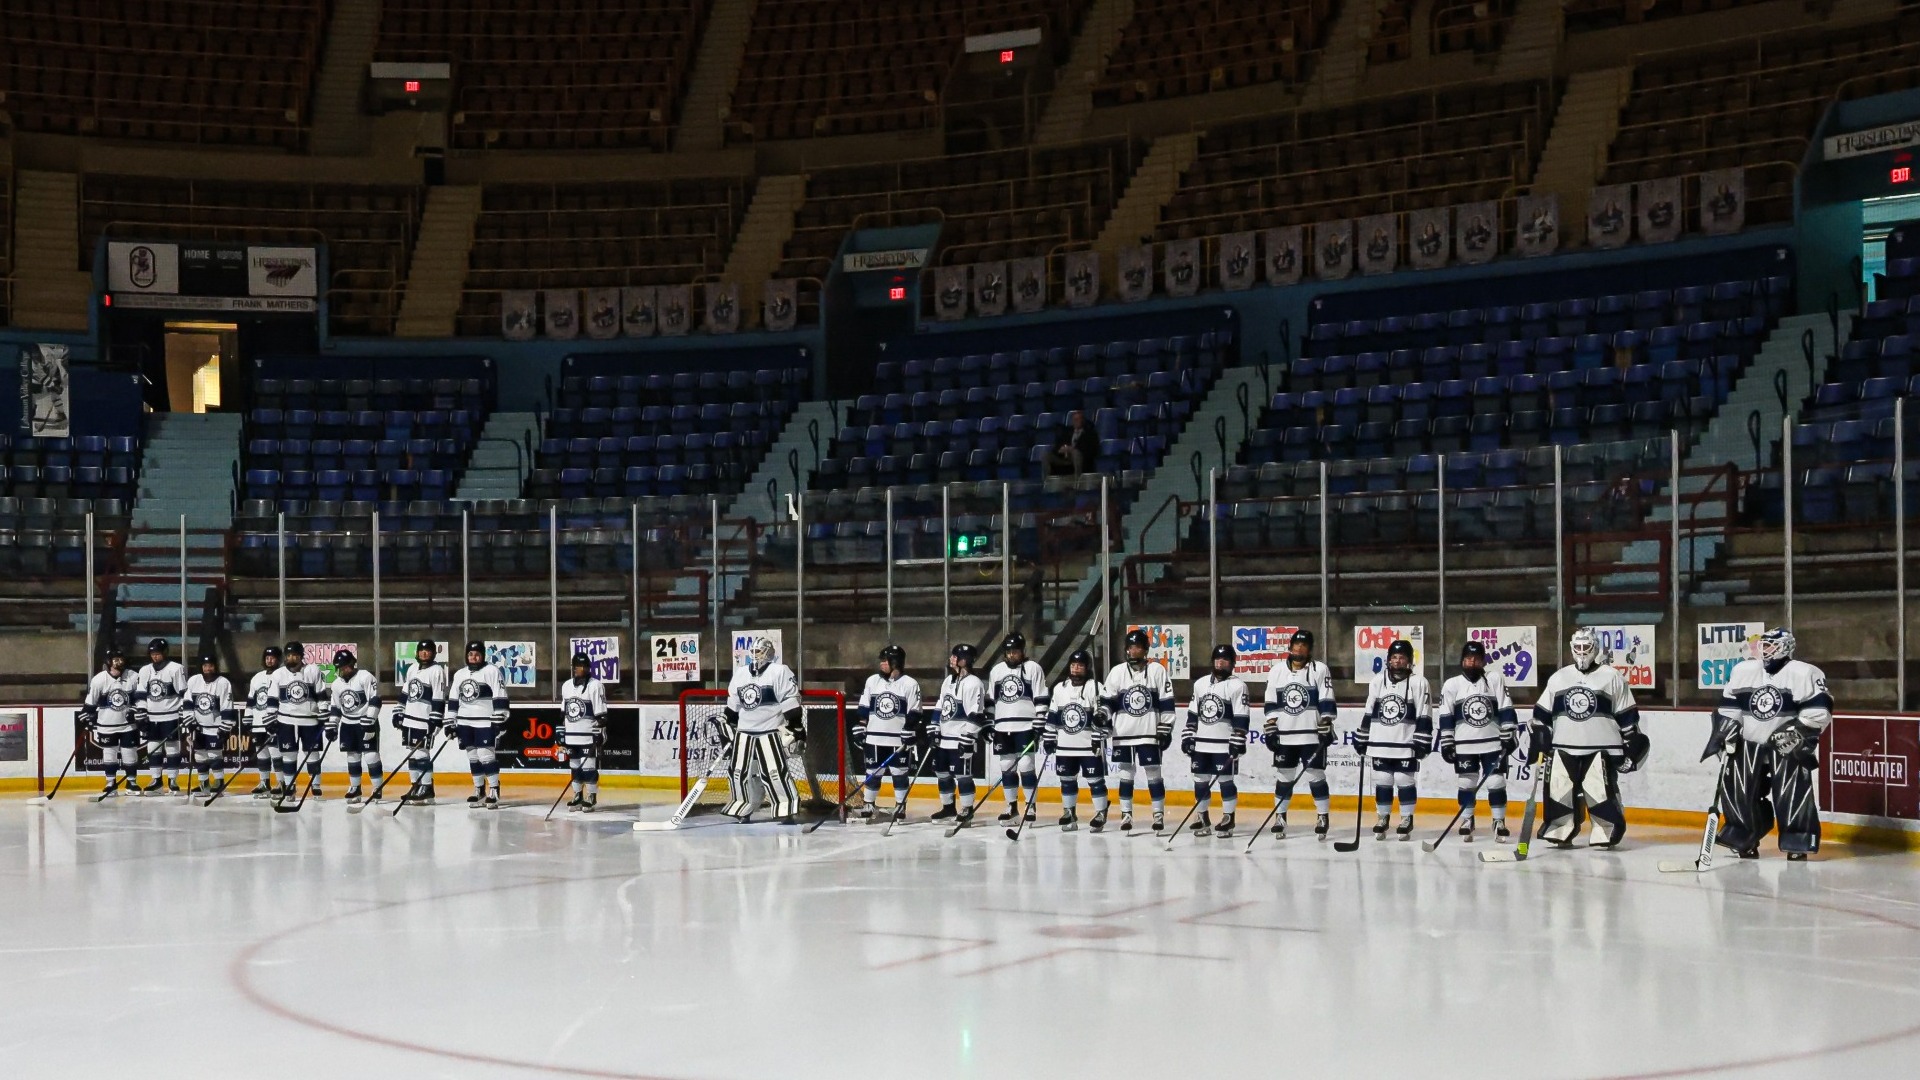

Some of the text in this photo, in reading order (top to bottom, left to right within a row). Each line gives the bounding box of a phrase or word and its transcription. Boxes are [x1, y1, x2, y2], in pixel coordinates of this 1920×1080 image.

[1836, 125, 1920, 153] HERSHEYPAR
[1892, 169, 1908, 183] EXIT
[184, 250, 209, 259] HOME
[891, 288, 904, 299] EXIT
[232, 300, 261, 309] FRANK
[266, 301, 309, 310] MATHERS
[1472, 629, 1497, 640] ONE
[1701, 625, 1745, 644] LITTLE
[681, 640, 697, 654] 68
[1503, 651, 1532, 681] #9
[1571, 699, 1588, 708] LVC
[652, 721, 698, 740] Klik
[672, 748, 706, 760] TUST
[1516, 765, 1530, 780] IS
[1834, 759, 1903, 779] CHOCOLATIER
